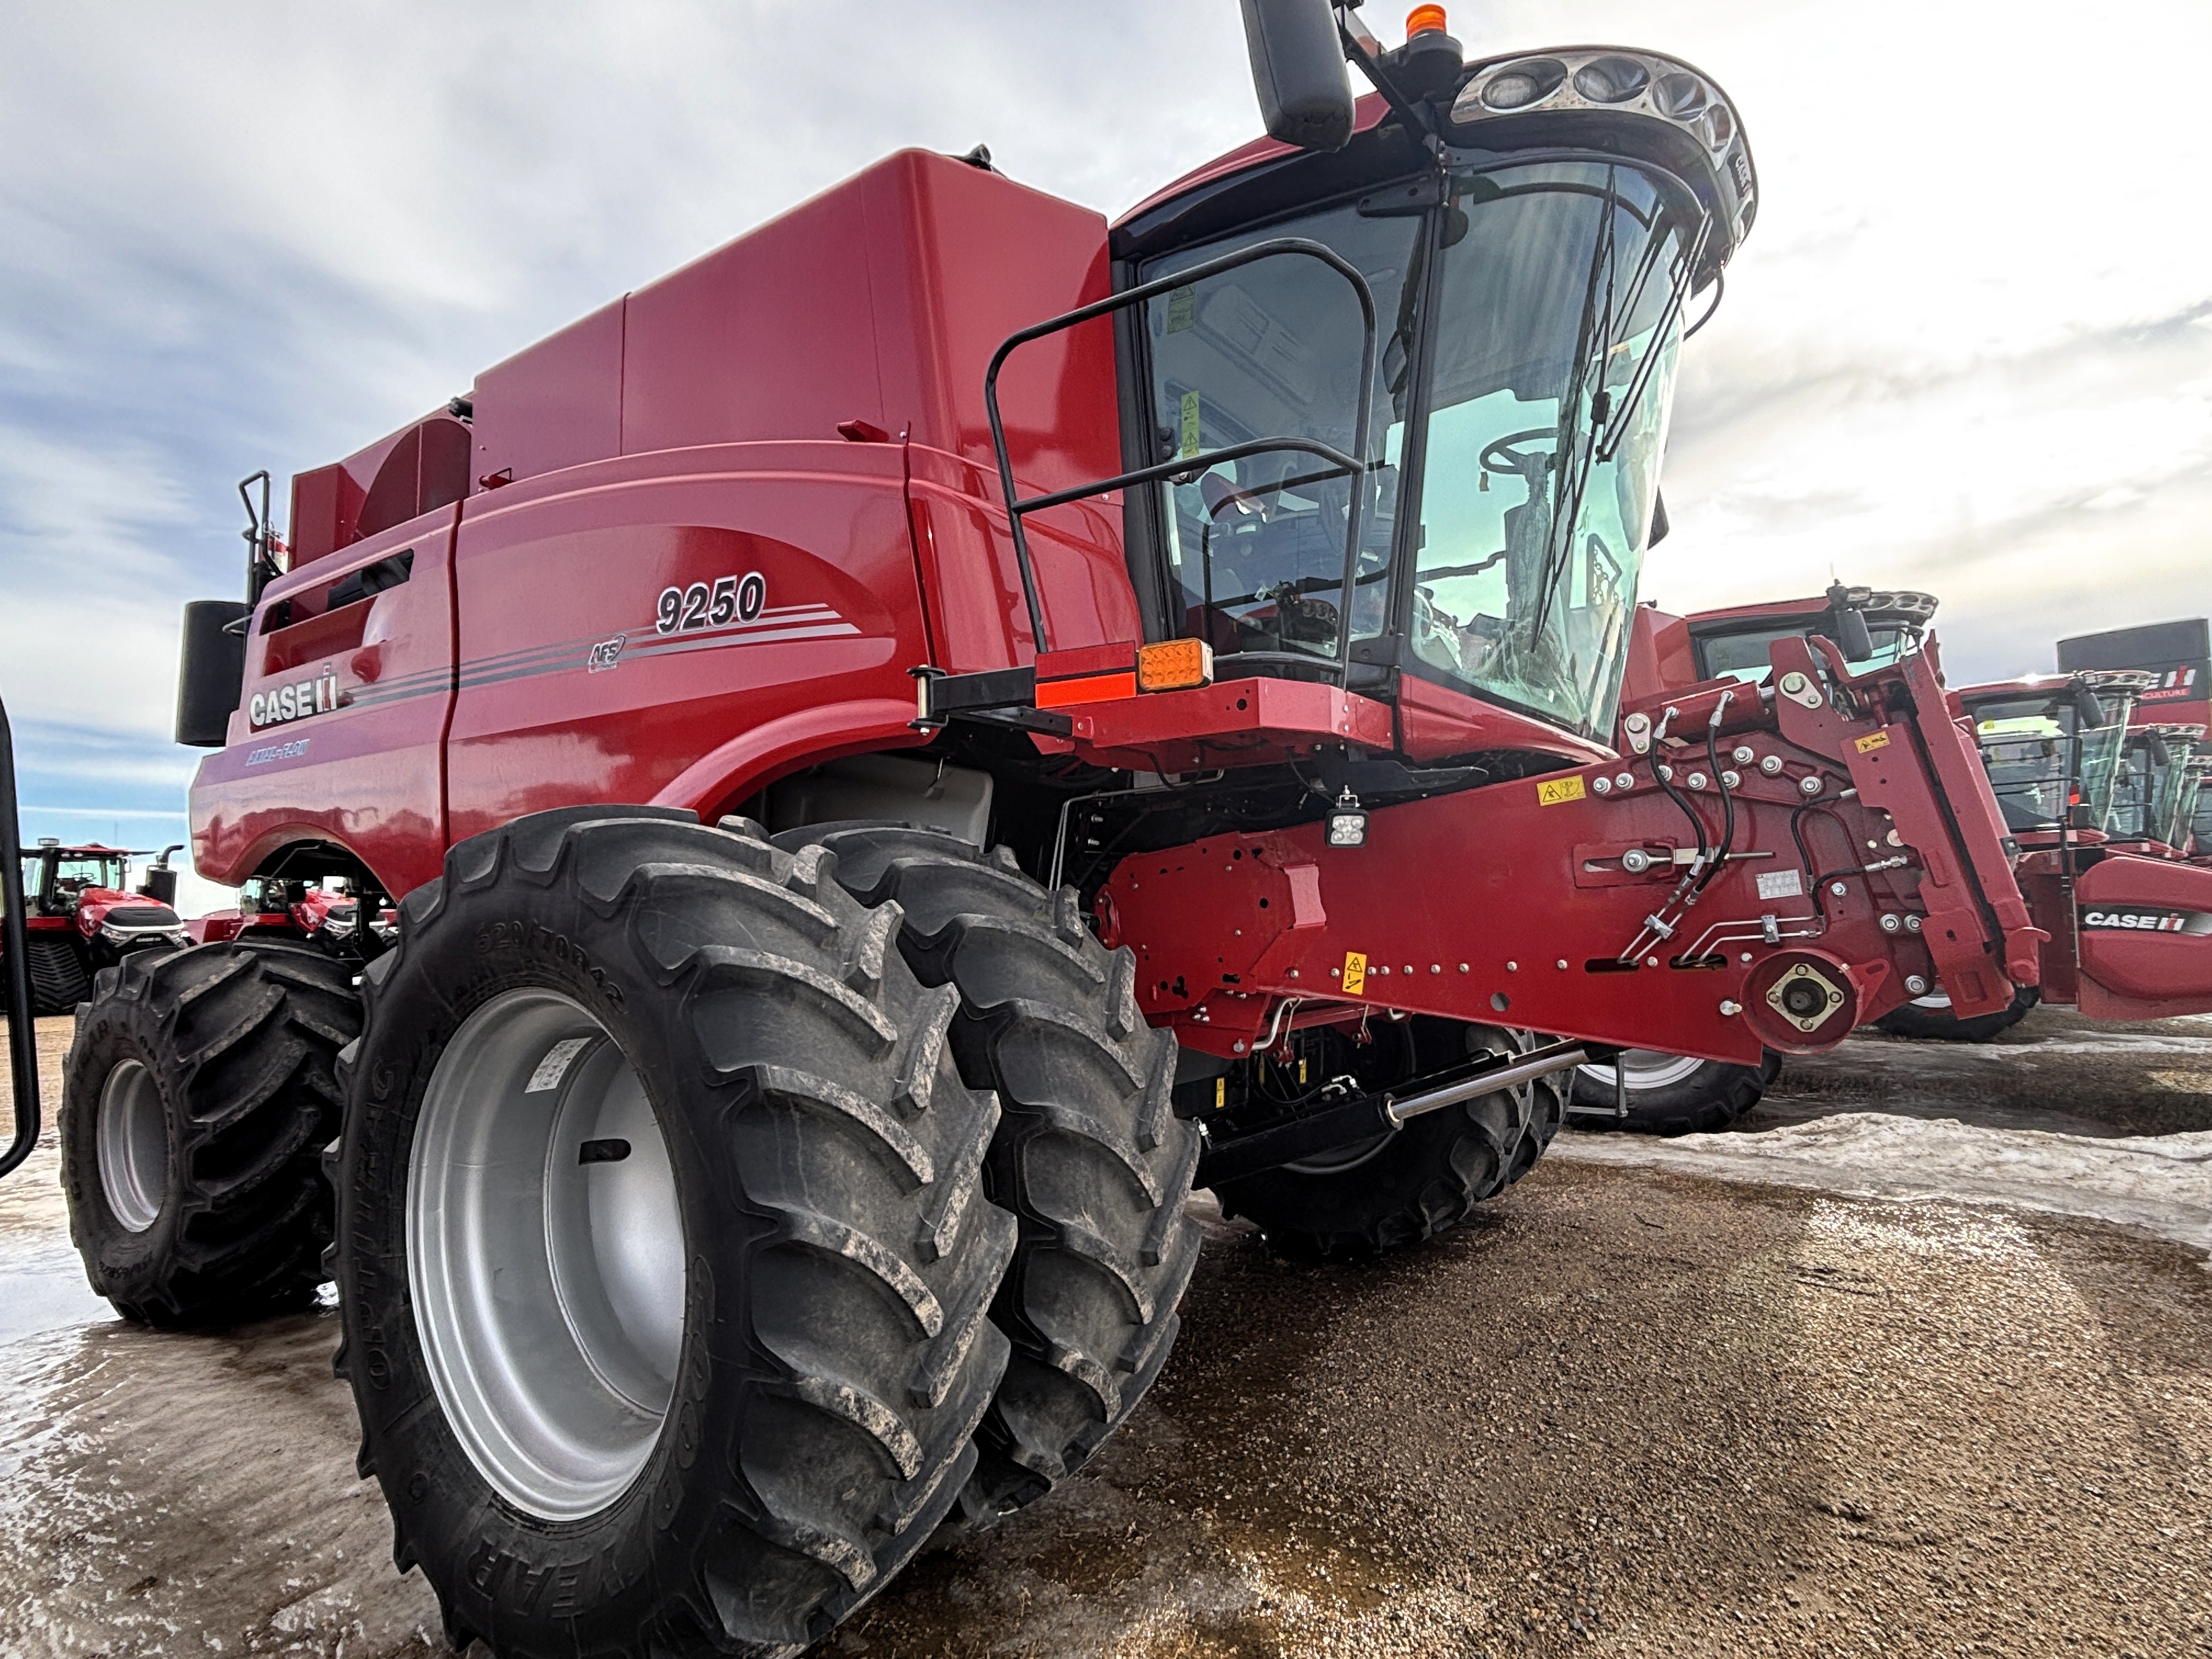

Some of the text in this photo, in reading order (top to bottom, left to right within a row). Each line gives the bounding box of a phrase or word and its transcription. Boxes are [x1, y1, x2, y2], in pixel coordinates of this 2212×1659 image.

[656, 571, 766, 634] 9250
[588, 638, 621, 664] AFS
[250, 682, 313, 726] CASE
[2141, 687, 2191, 700] CULTURE
[2085, 912, 2158, 929] CASE
